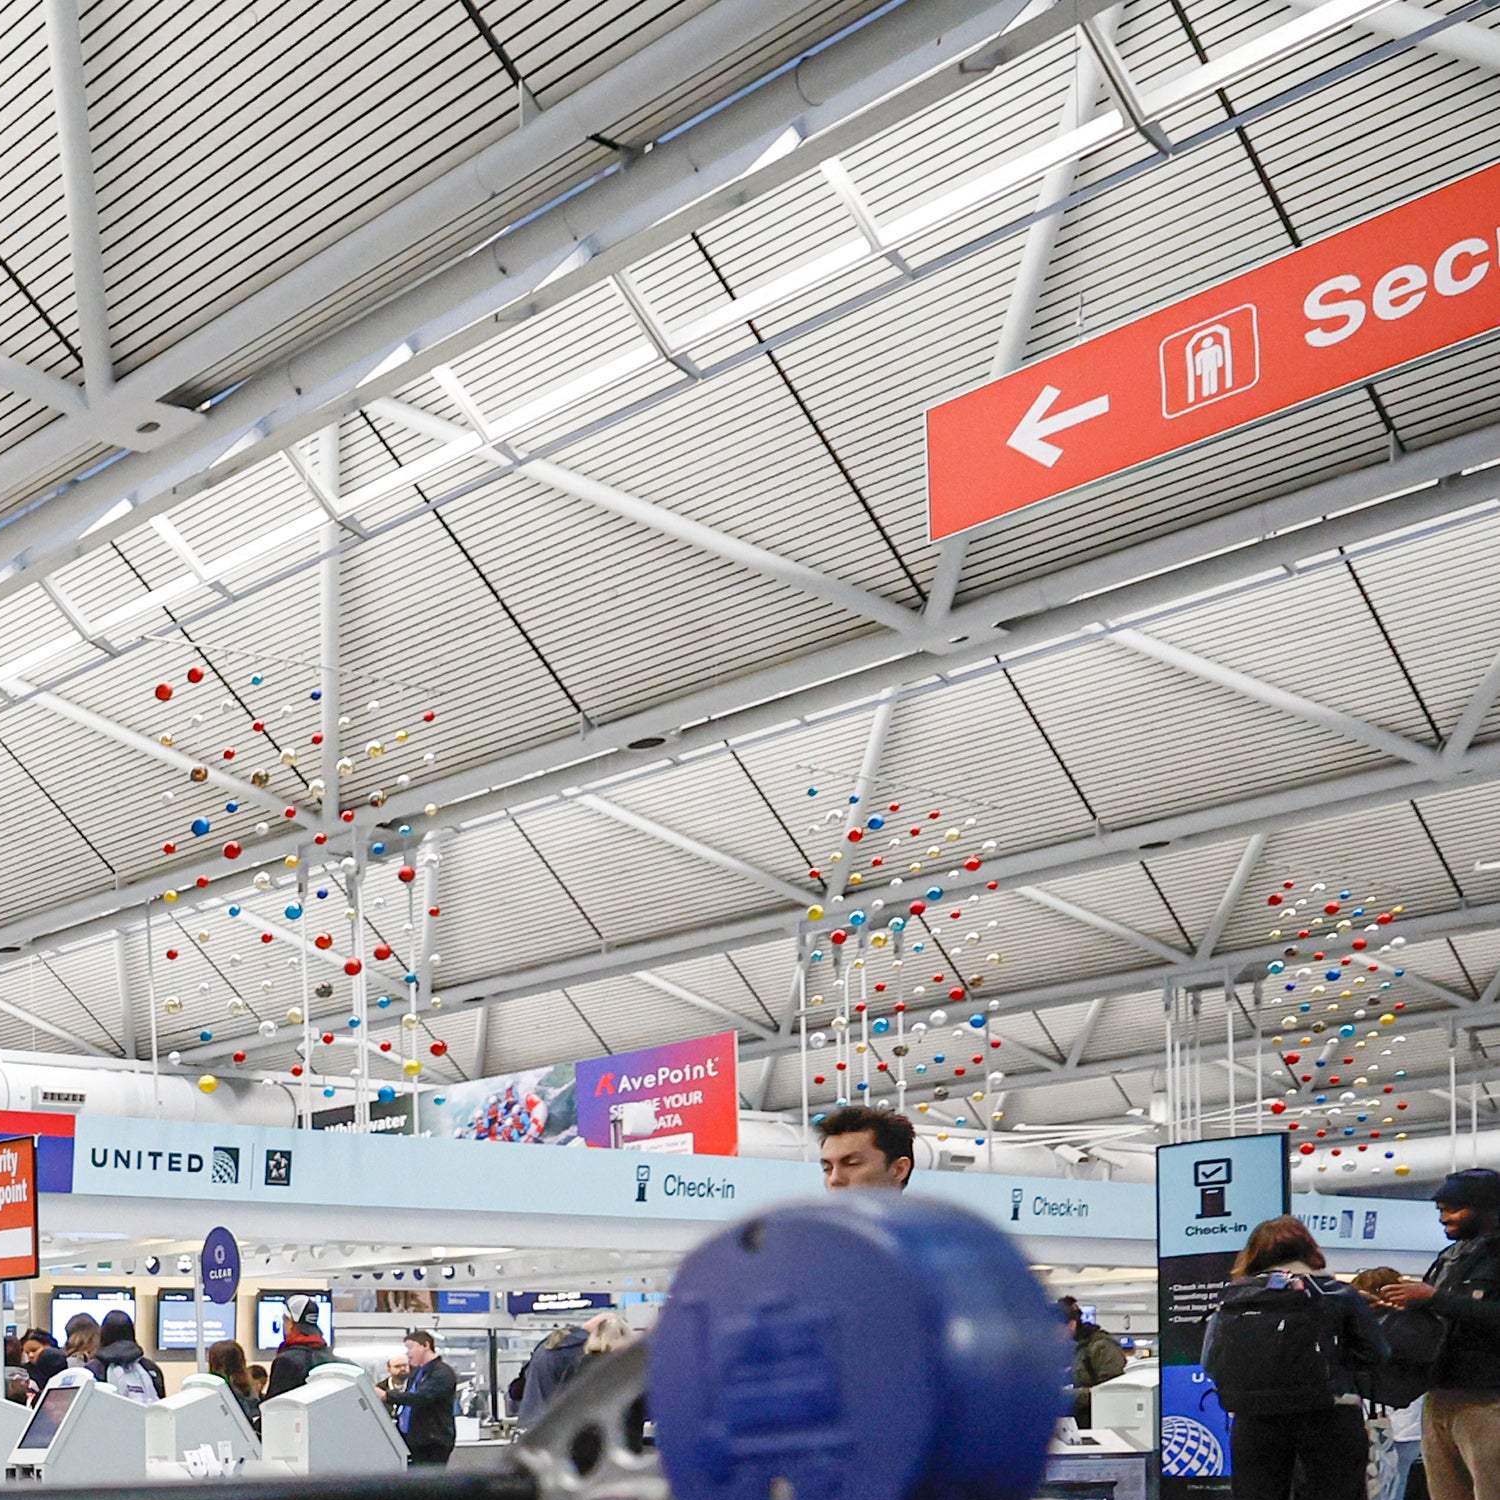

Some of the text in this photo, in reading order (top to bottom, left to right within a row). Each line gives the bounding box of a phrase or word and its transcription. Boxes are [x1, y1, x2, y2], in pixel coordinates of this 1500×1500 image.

[1303, 227, 1500, 347] Sec
[617, 1059, 718, 1094] AvePoint
[662, 1090, 704, 1109] YOUR
[91, 1147, 204, 1172] UNITED
[664, 1174, 735, 1199] Check-in
[1033, 1196, 1088, 1217] Check-in
[1185, 1222, 1248, 1236] Check-in
